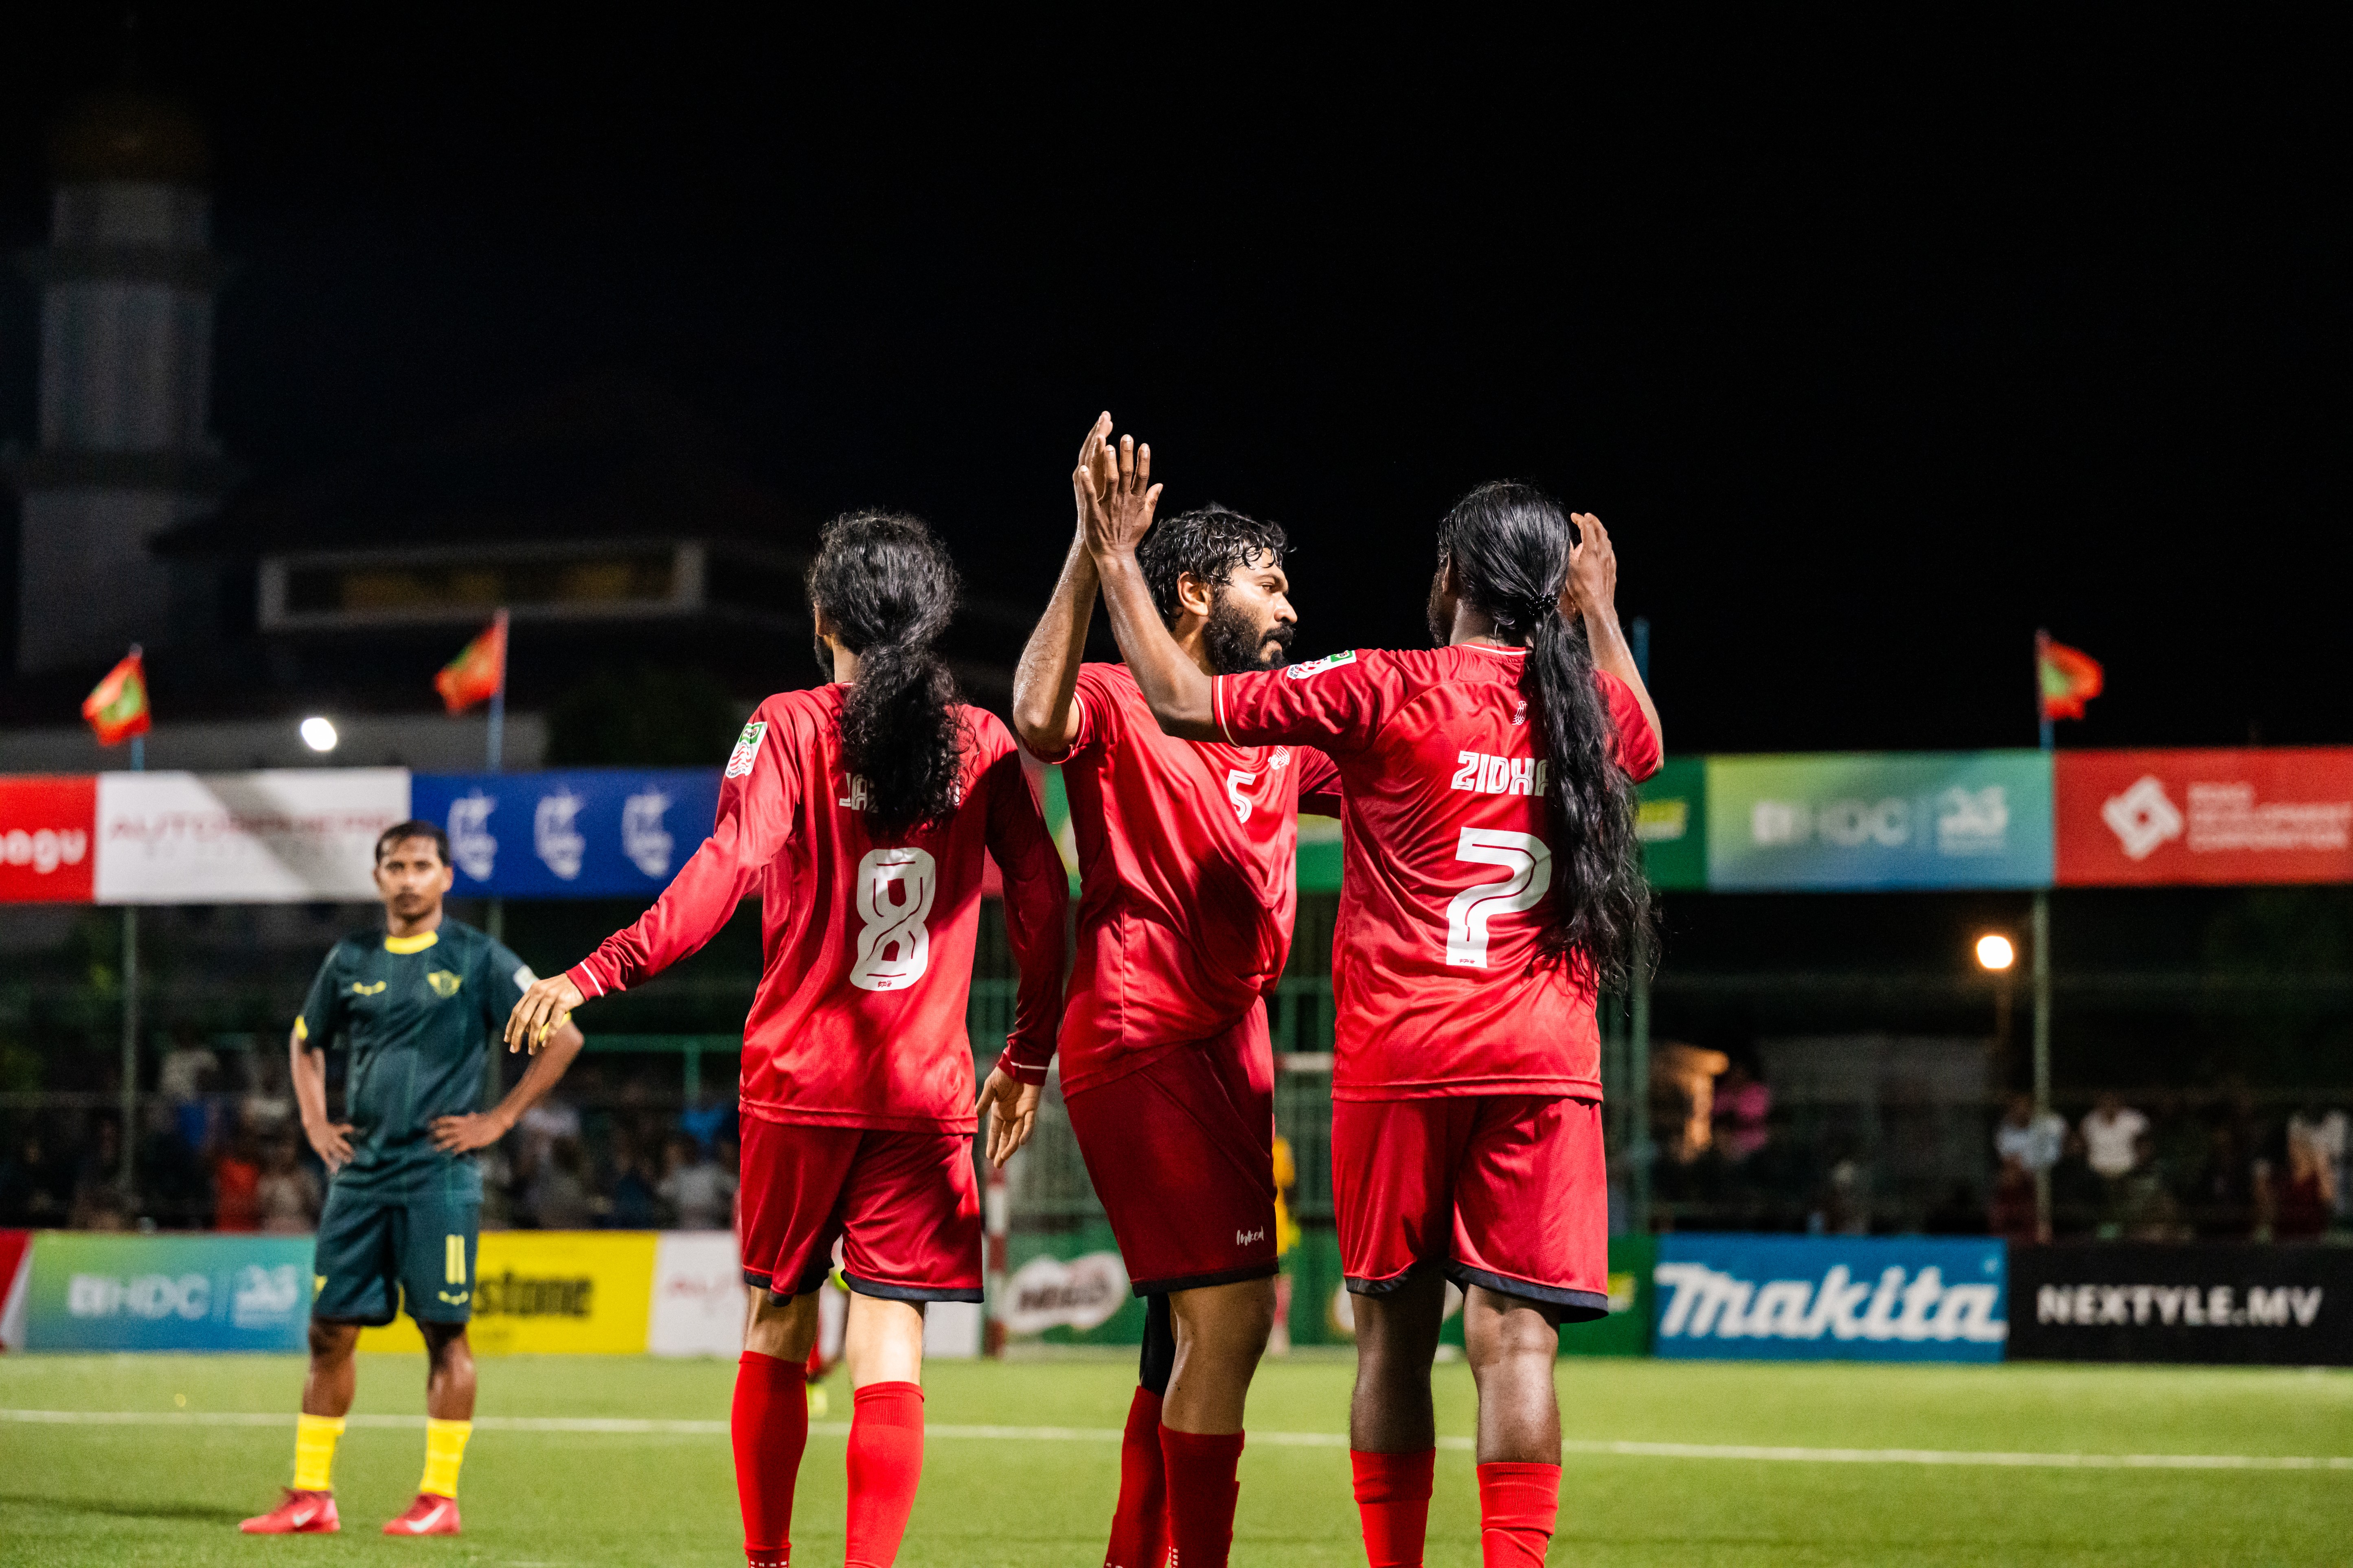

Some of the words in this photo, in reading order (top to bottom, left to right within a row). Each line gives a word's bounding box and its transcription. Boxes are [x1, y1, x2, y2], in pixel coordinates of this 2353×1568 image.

[1226, 769, 1256, 823] 5
[1451, 751, 1550, 797] ZIDHA
[849, 847, 936, 991] 8
[1445, 827, 1552, 968] 7
[445, 1235, 466, 1284] 11
[476, 1265, 594, 1318] stone
[2037, 1283, 2323, 1327] NEXTYLE.MV
